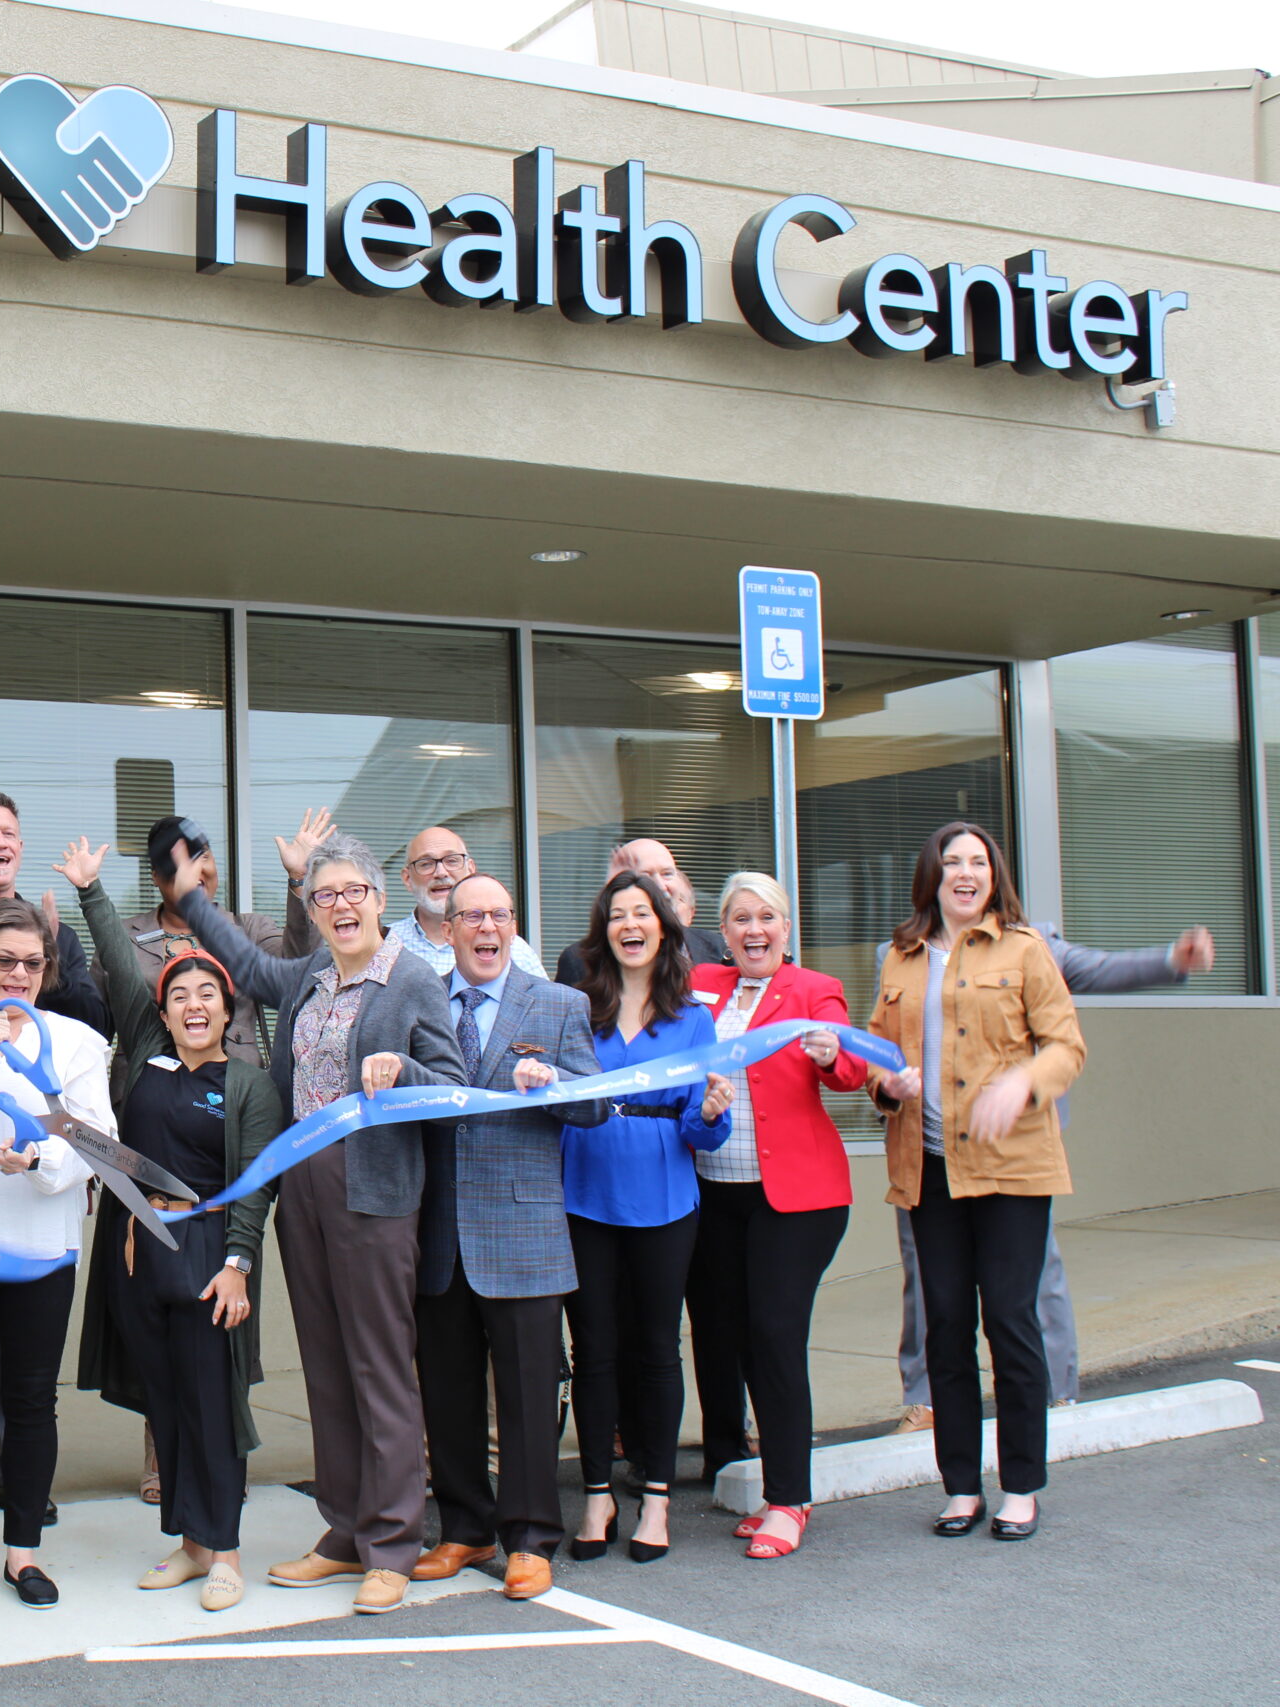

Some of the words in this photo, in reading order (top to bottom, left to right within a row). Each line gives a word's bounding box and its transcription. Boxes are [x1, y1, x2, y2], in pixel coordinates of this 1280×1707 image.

[202, 109, 703, 326] Health
[735, 193, 1188, 380] Center
[746, 582, 768, 594] PERMIT
[770, 585, 796, 596] PARKING
[798, 587, 813, 598] ONLY
[757, 605, 788, 617] TOW-AWAY
[789, 607, 805, 618] ZONE
[748, 688, 776, 700] MAXIMUM
[778, 691, 791, 702] FINE
